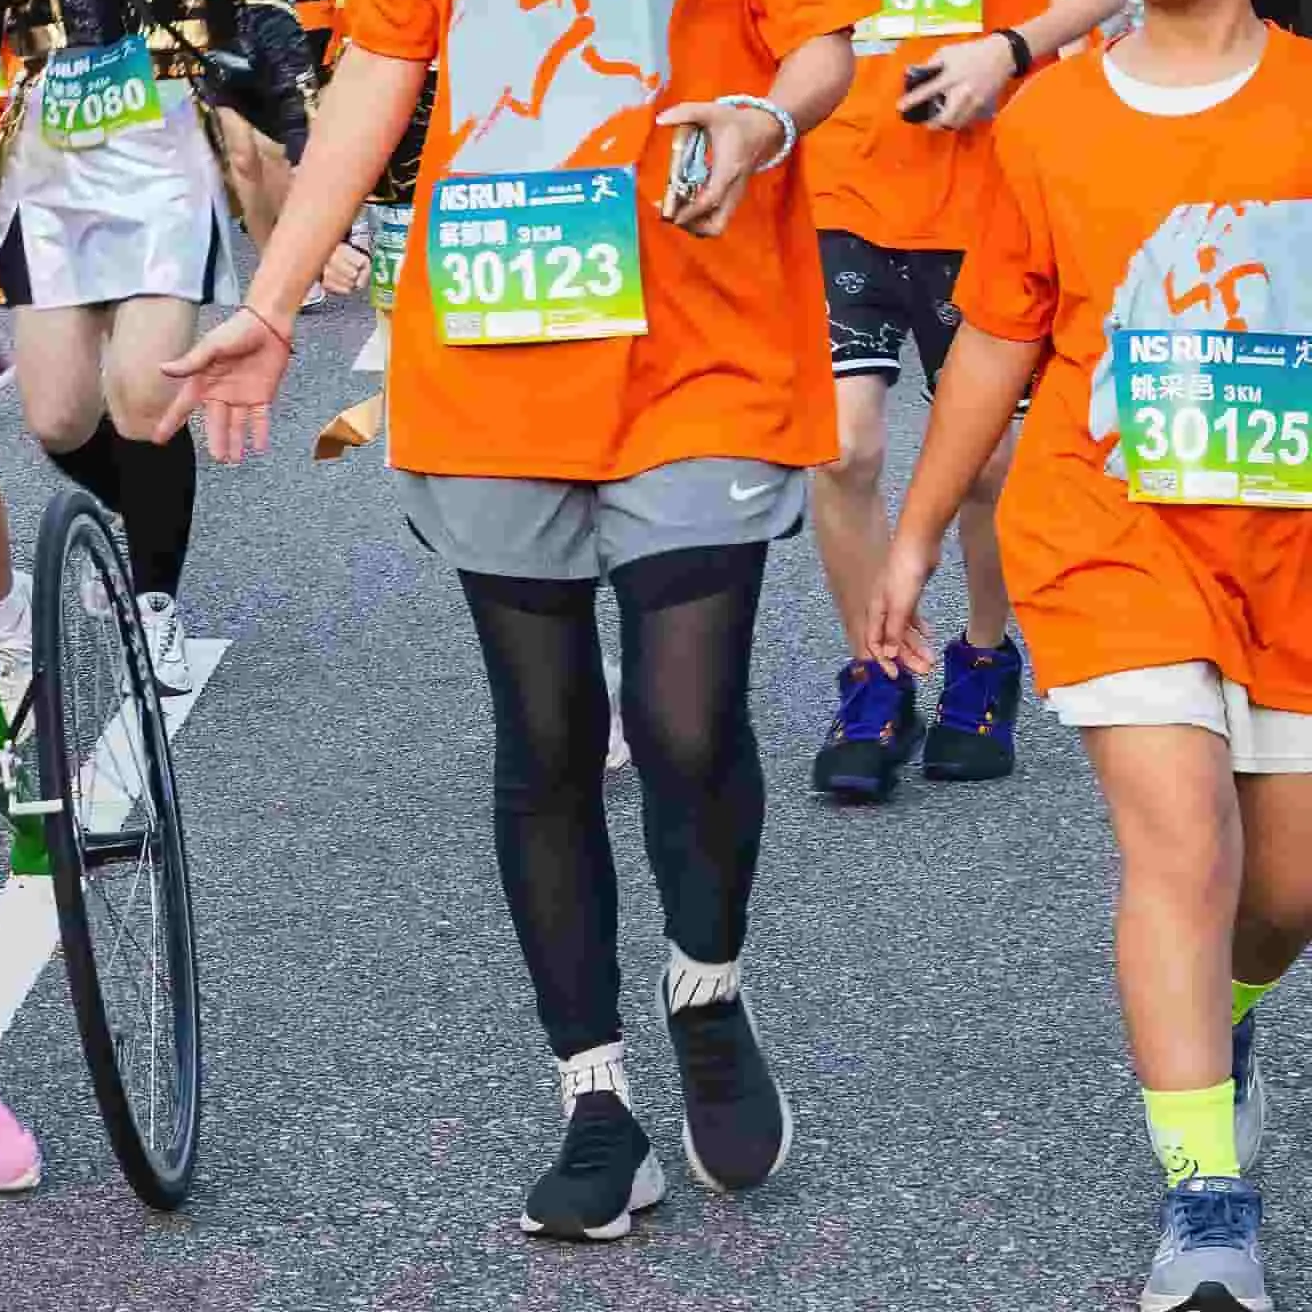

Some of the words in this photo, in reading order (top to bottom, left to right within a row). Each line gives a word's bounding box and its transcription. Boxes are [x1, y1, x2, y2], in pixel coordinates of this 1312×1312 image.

[45, 77, 147, 129] 37080
[439, 181, 525, 211] NSRUN
[441, 243, 624, 305] 30123
[1134, 406, 1310, 465] 30125
